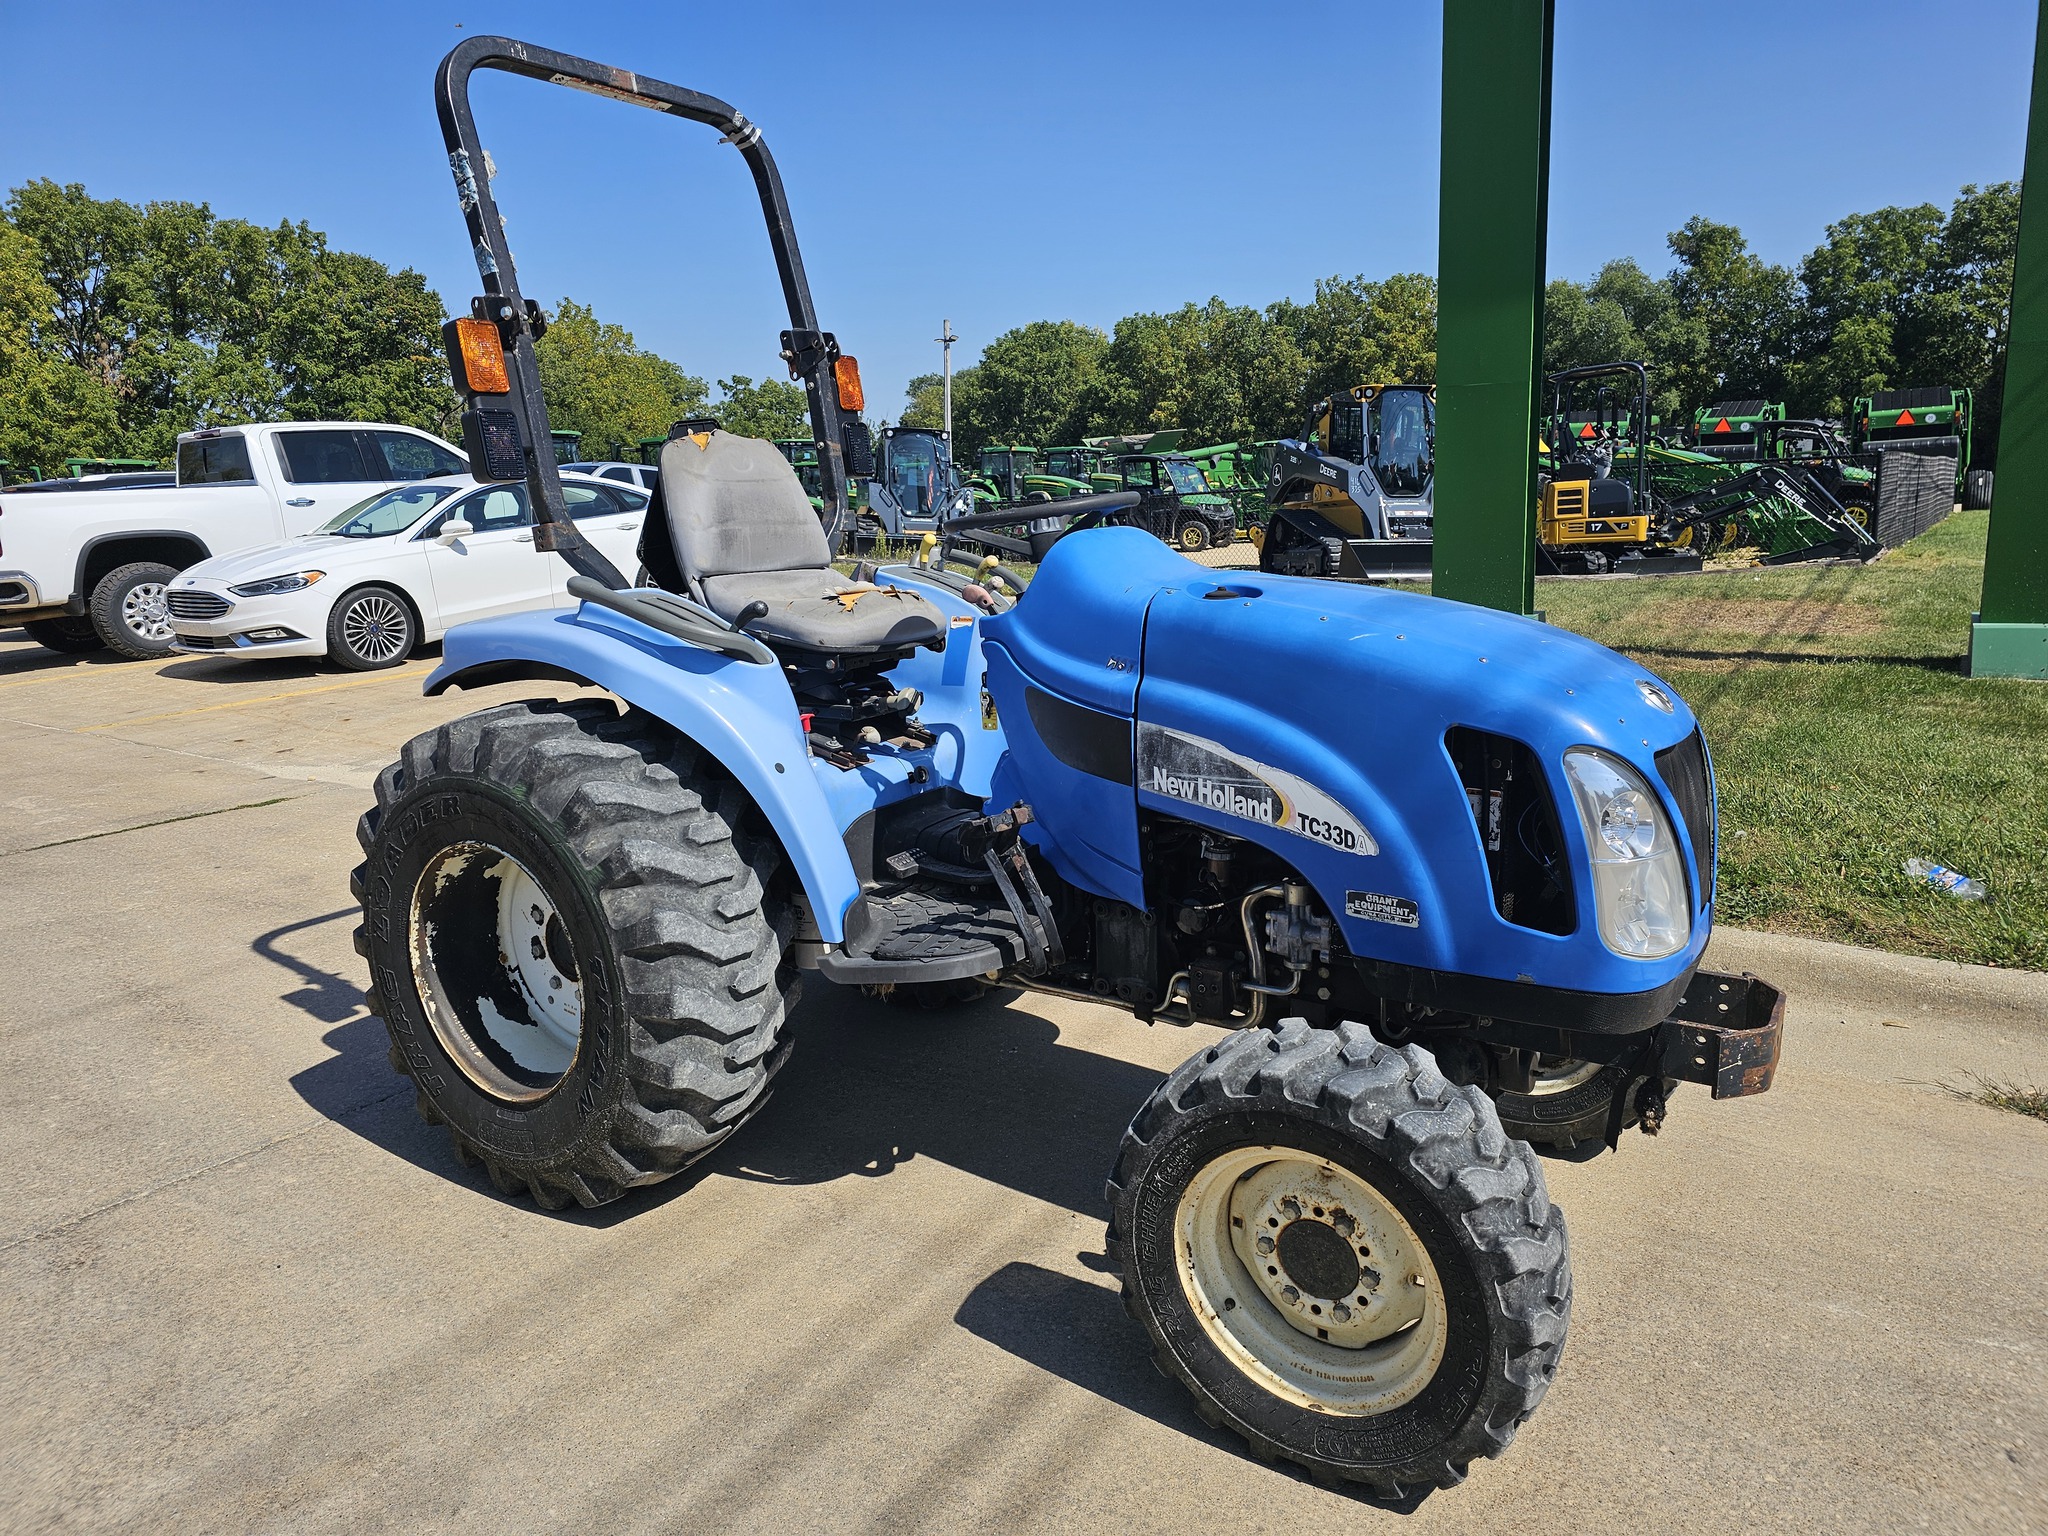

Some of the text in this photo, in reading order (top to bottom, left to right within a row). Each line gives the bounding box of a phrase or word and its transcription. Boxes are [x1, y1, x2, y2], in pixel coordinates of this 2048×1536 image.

[1319, 463, 1338, 480] DEERE
[1774, 478, 1807, 507] DEERE
[1590, 523, 1603, 532] 17
[1153, 765, 1273, 824] New Holland
[371, 795, 464, 945] LOADER
[1354, 899, 1410, 917] EQUIPMENT
[1365, 894, 1399, 907] GRANT
[377, 964, 448, 1098] TRAC
[576, 955, 612, 1119] TITAN
[1138, 1176, 1166, 1265] CHIEF
[1147, 1274, 1198, 1360] TRAC
